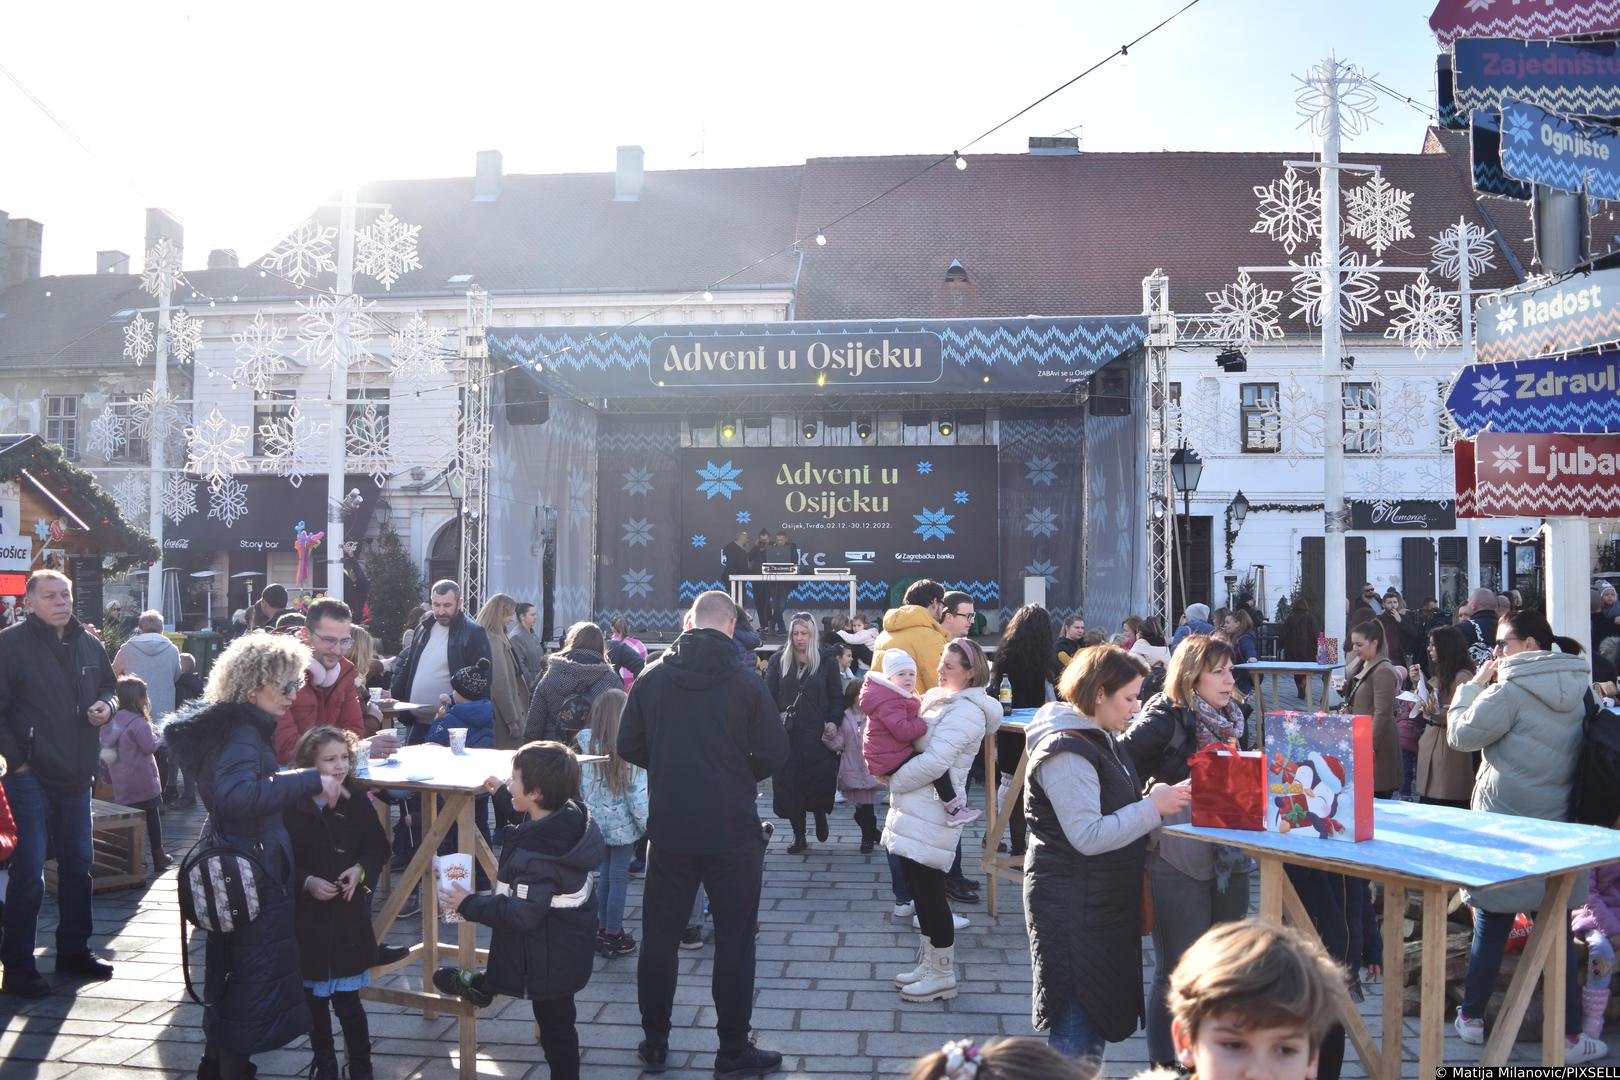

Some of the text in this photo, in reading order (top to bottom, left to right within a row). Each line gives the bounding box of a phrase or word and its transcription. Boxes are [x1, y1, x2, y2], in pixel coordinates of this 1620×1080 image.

[1541, 124, 1609, 160] Ognjište
[1522, 285, 1602, 328] Radost
[663, 339, 922, 376] Advent u Osijeku
[776, 461, 898, 485] Advent u
[785, 489, 889, 519] Osijeku
[240, 540, 280, 551] Story bar
[936, 552, 955, 560] banka
